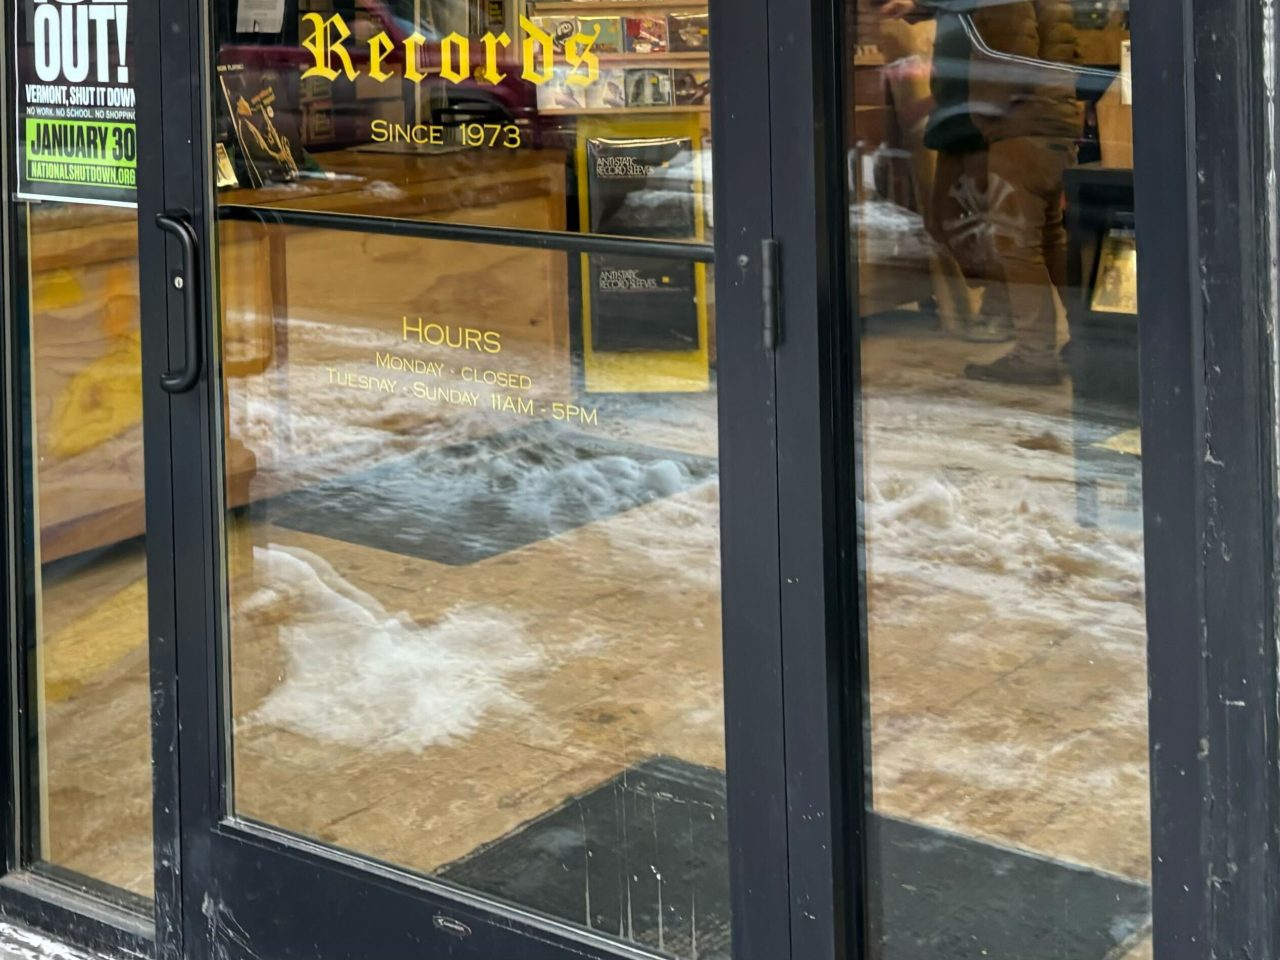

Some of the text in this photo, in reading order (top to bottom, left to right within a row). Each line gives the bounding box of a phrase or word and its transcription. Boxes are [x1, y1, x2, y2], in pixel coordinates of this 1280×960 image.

[34, 3, 129, 84] OUT!
[300, 12, 602, 87] Records
[25, 83, 69, 107] VERMONT,
[69, 86, 96, 107] SHUT
[96, 87, 107, 106] IT
[26, 106, 35, 116] NO
[56, 108, 66, 118] NO
[95, 108, 105, 119] NO
[31, 123, 136, 161] JANUARY 30
[460, 123, 521, 149] 1973
[31, 160, 136, 185] NATIONALSHUTDOWN.ORG
[552, 402, 599, 426] 5PM
